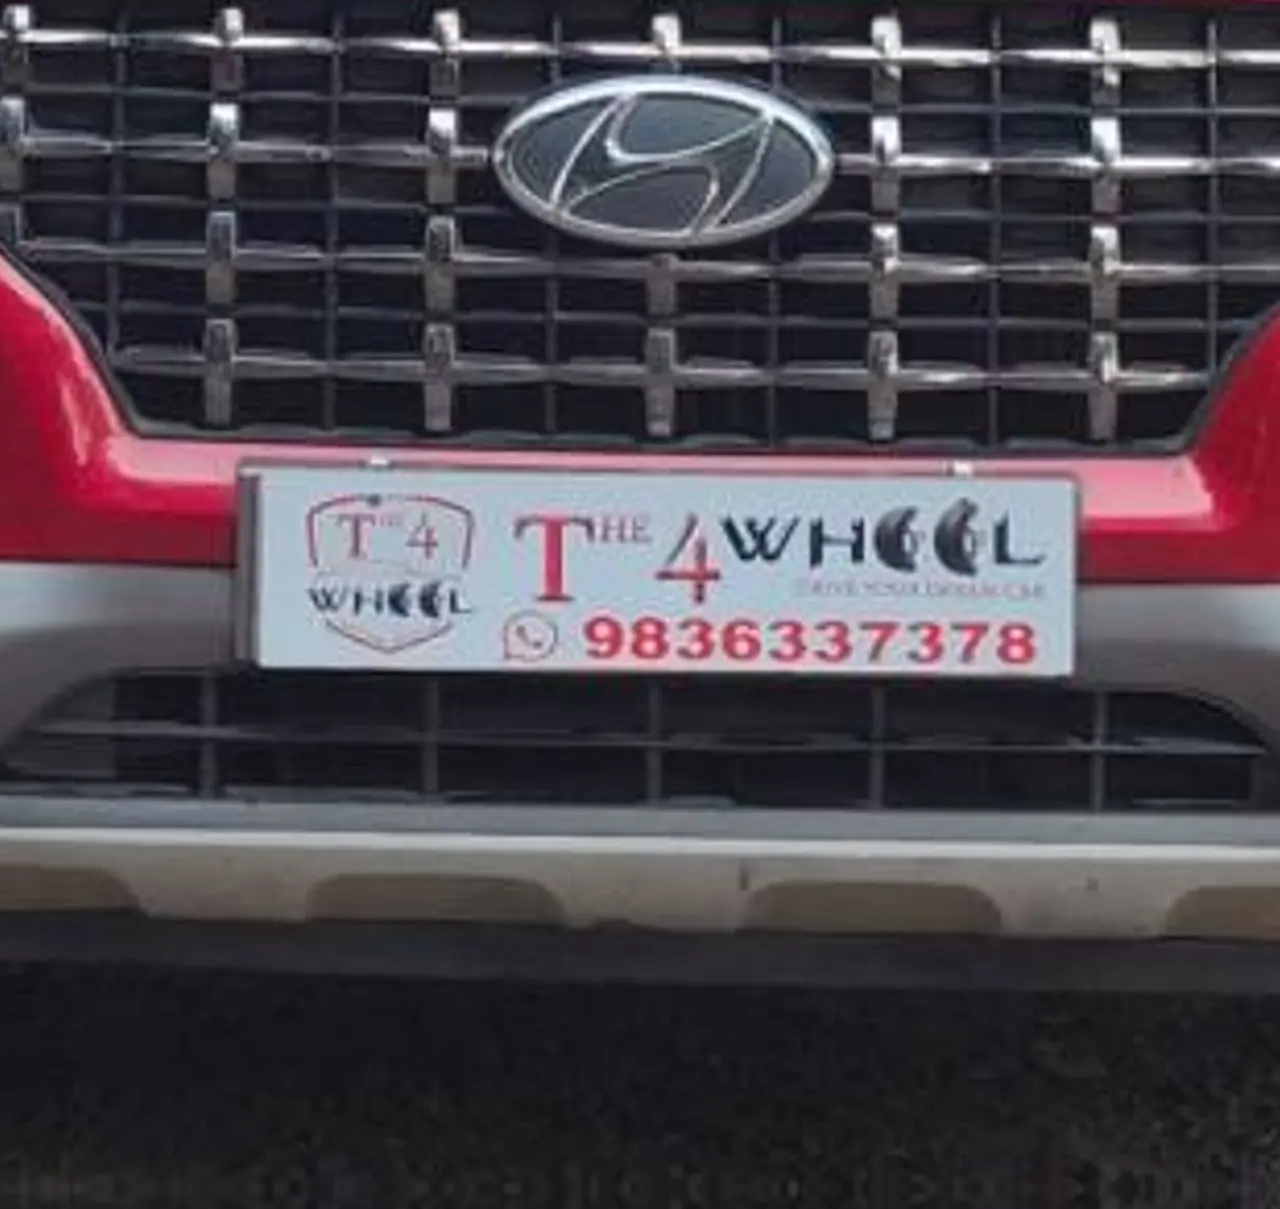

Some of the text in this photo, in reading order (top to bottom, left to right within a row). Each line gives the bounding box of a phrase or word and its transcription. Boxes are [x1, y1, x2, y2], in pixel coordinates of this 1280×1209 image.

[405, 512, 439, 560] 4
[513, 514, 652, 602] THE
[583, 616, 1036, 665] 9836337378
